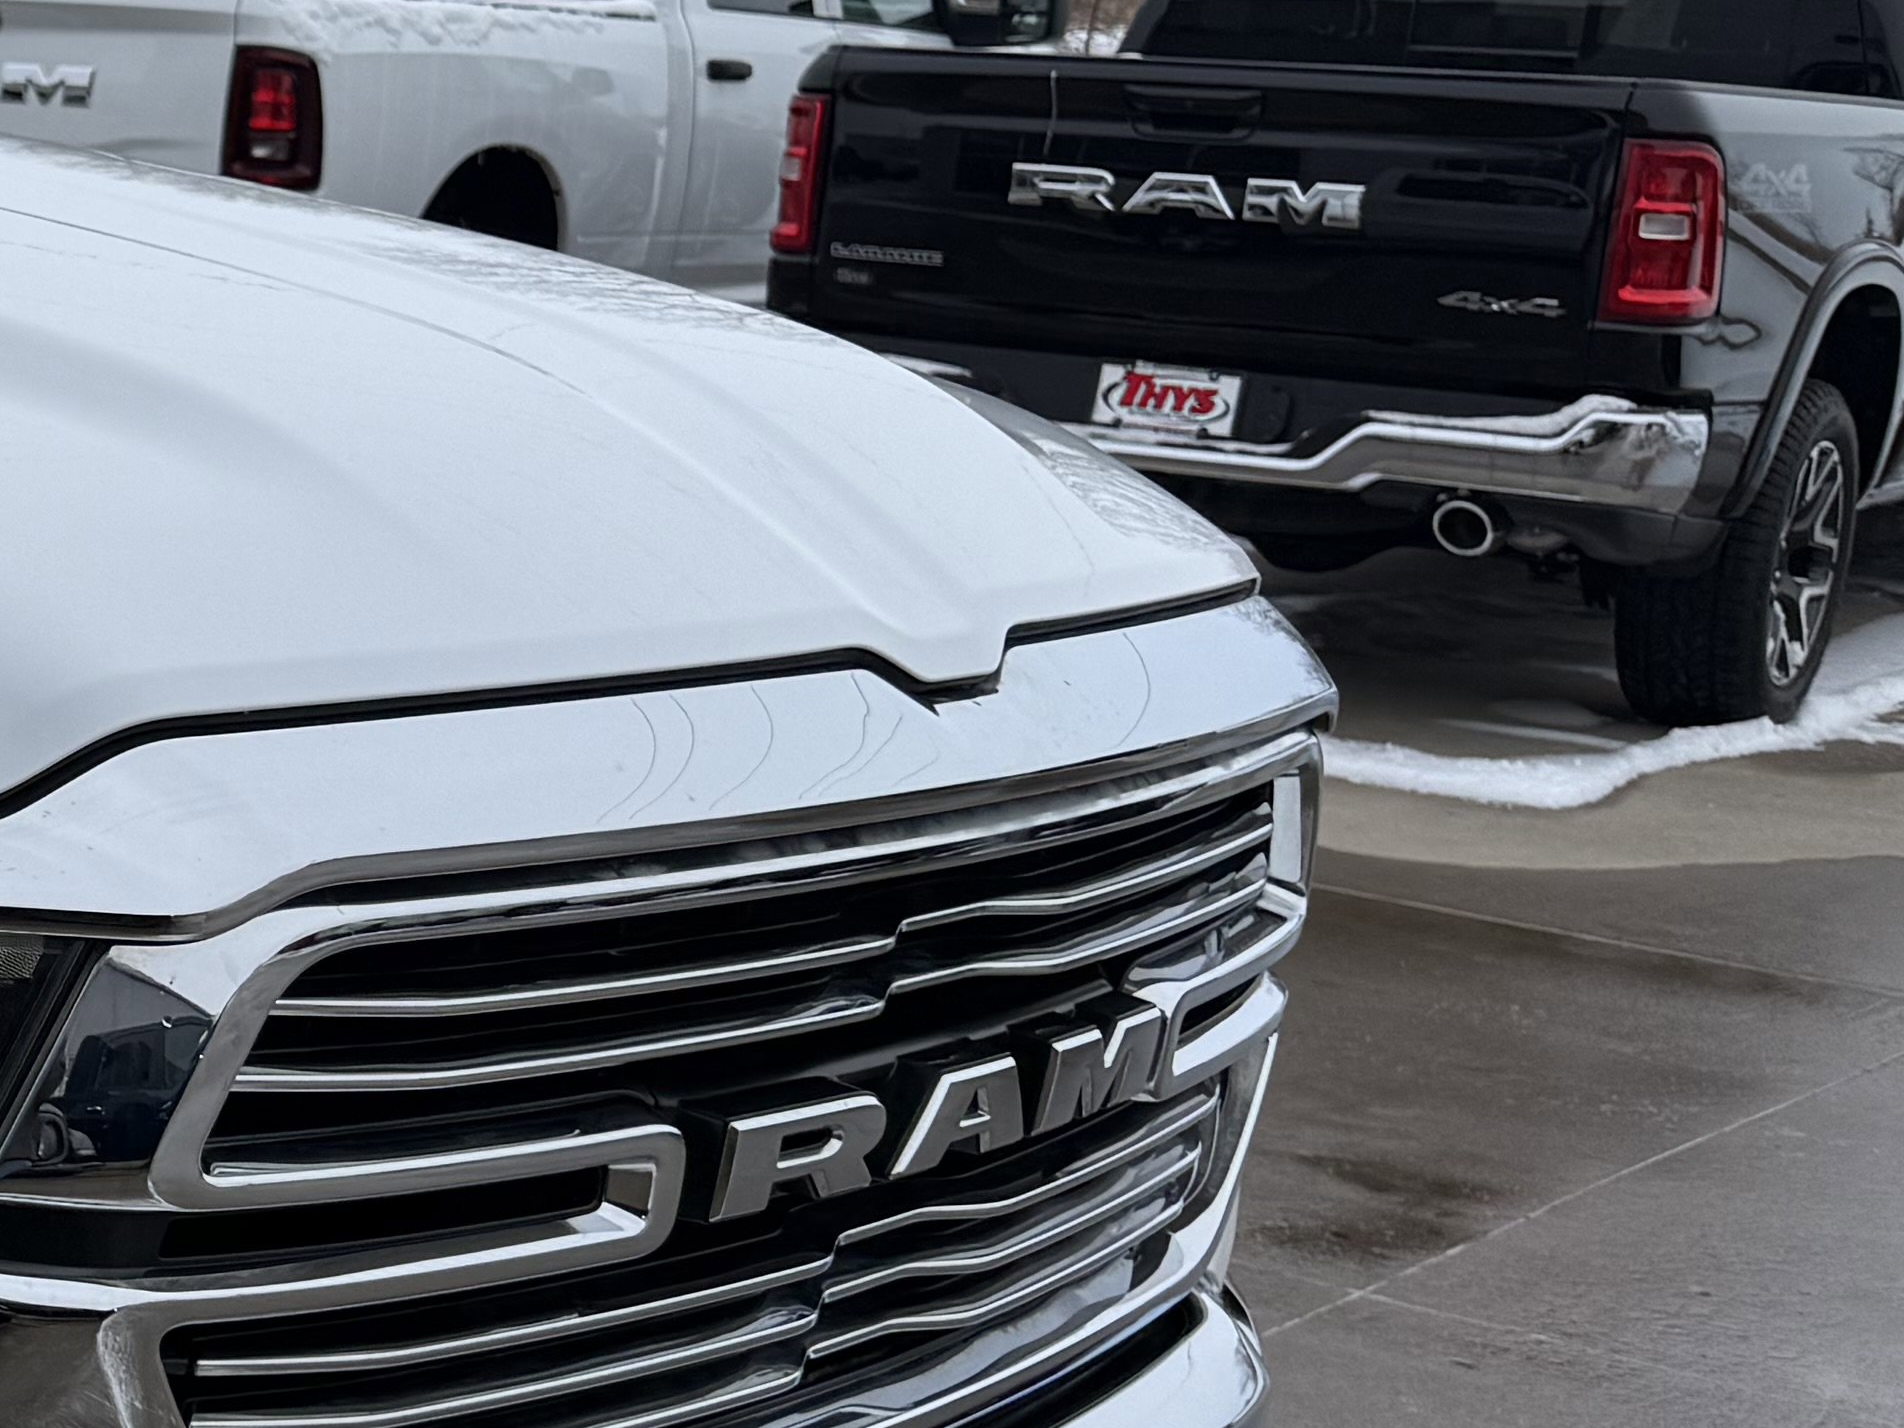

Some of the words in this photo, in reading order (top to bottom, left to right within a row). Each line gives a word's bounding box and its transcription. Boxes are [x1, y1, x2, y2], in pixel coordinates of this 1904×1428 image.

[1007, 162, 1366, 230] RAM
[1119, 372, 1219, 414] THYS
[706, 1004, 1166, 1223] RAM
